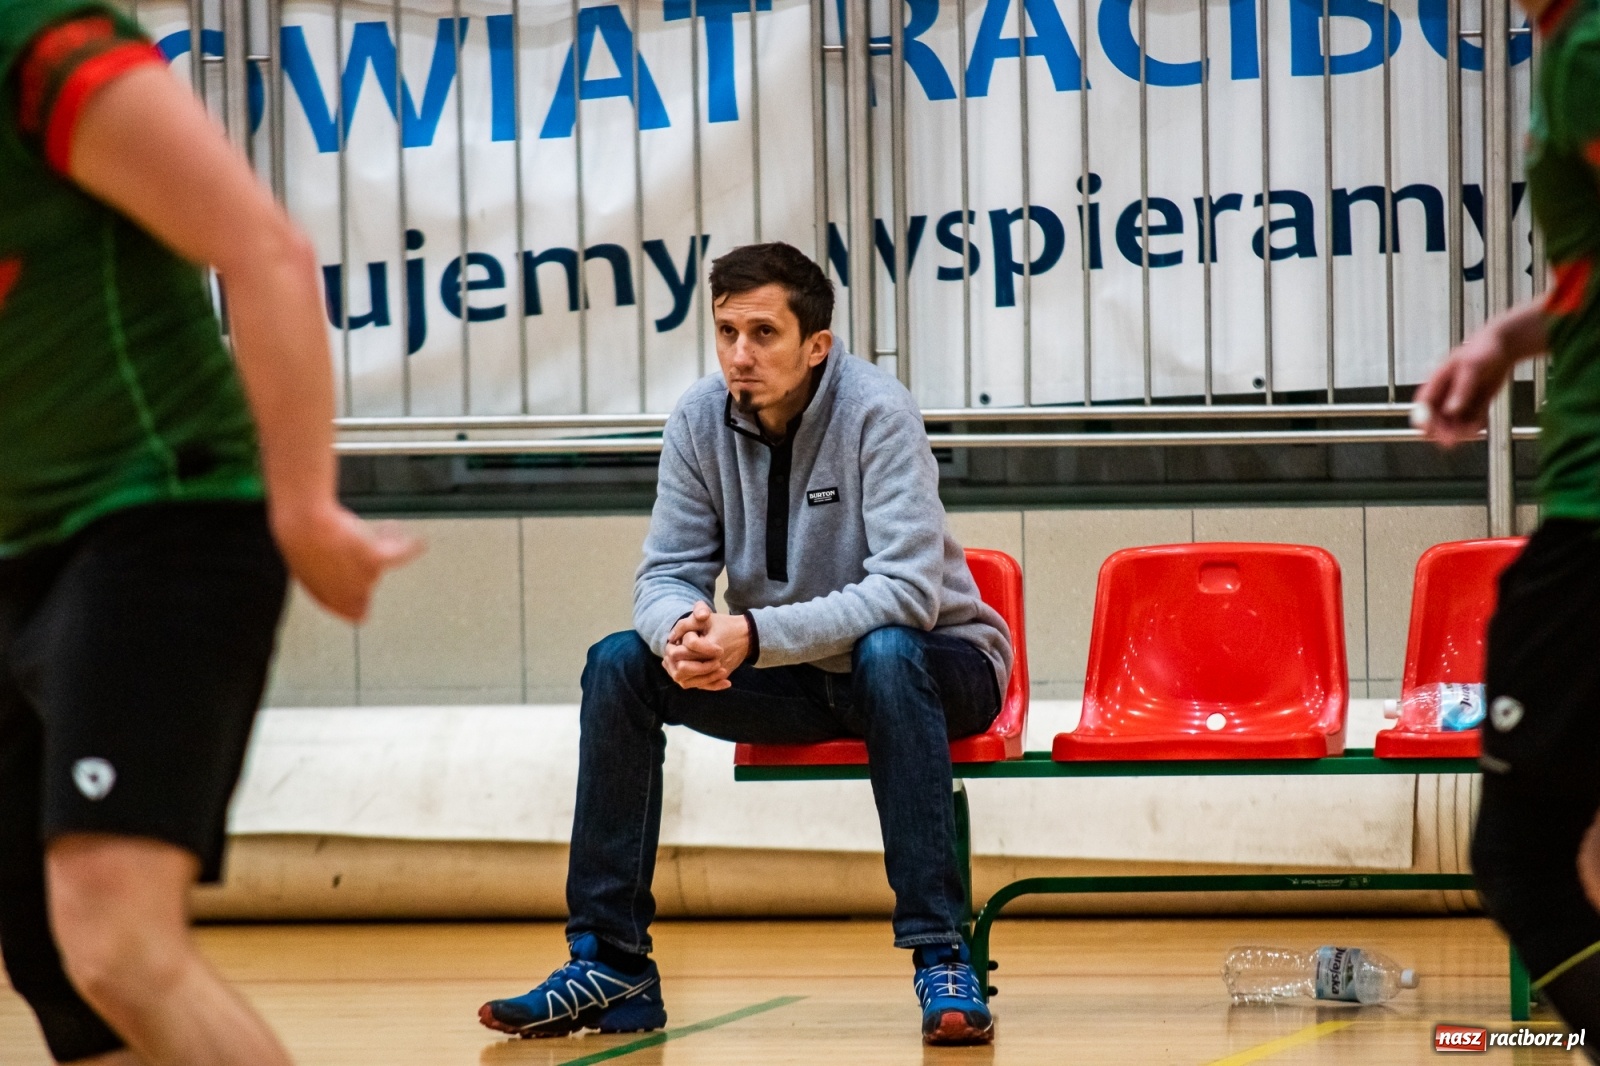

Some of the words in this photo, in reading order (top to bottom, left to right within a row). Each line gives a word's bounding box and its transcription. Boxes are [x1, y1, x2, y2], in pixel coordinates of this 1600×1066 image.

[218, 229, 710, 355] ujemy
[827, 172, 1532, 308] wspieramy
[809, 490, 836, 499] BURTON
[1330, 947, 1347, 995] Jurajska
